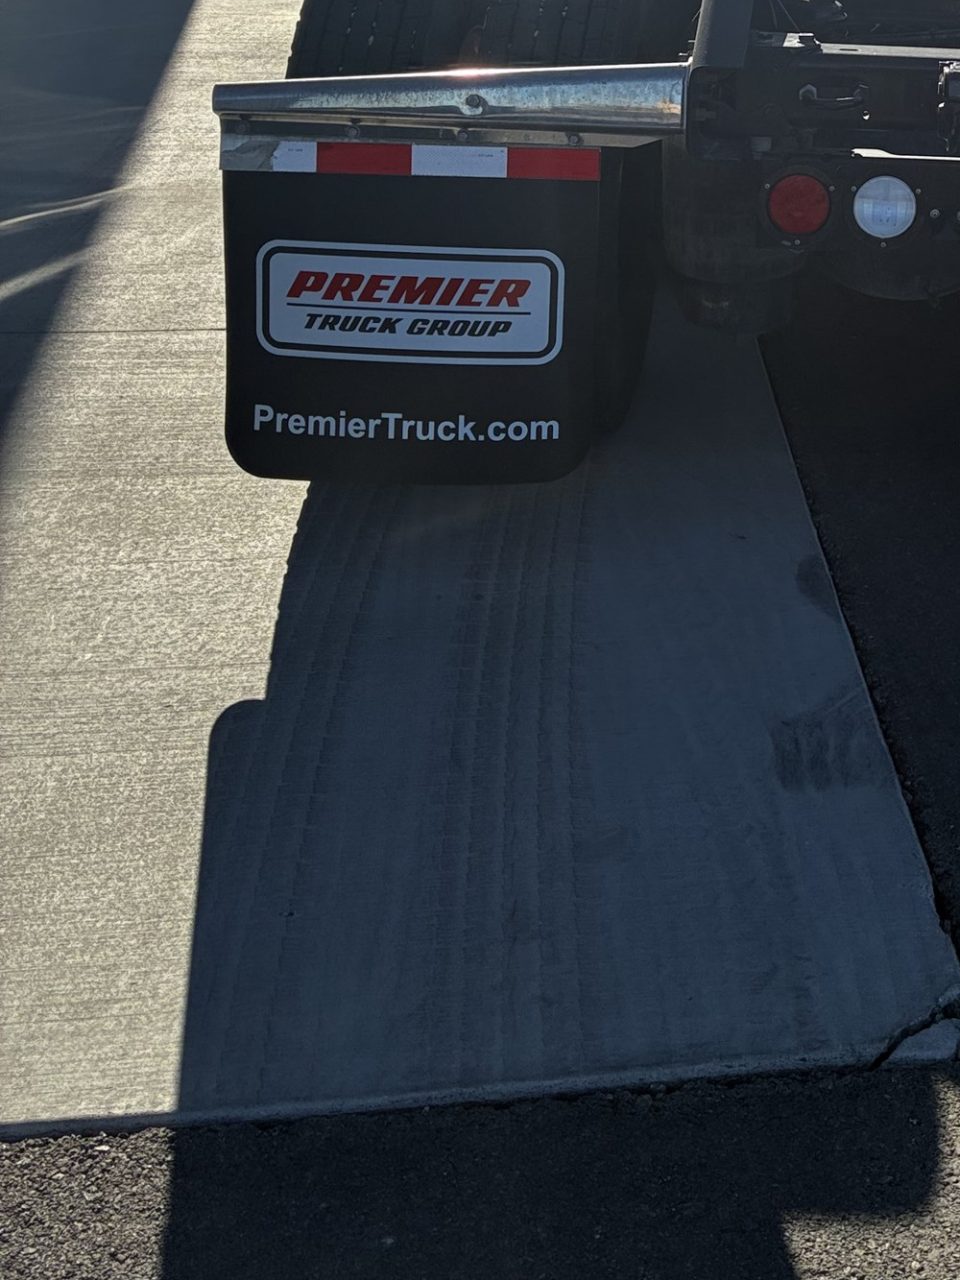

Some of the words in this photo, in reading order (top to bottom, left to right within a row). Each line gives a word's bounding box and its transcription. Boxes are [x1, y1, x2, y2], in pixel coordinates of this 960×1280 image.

[286, 271, 531, 308] PREMIER
[303, 313, 404, 335] TRUCK
[406, 318, 513, 338] GROUP
[253, 403, 561, 442] PremierTruck.com
